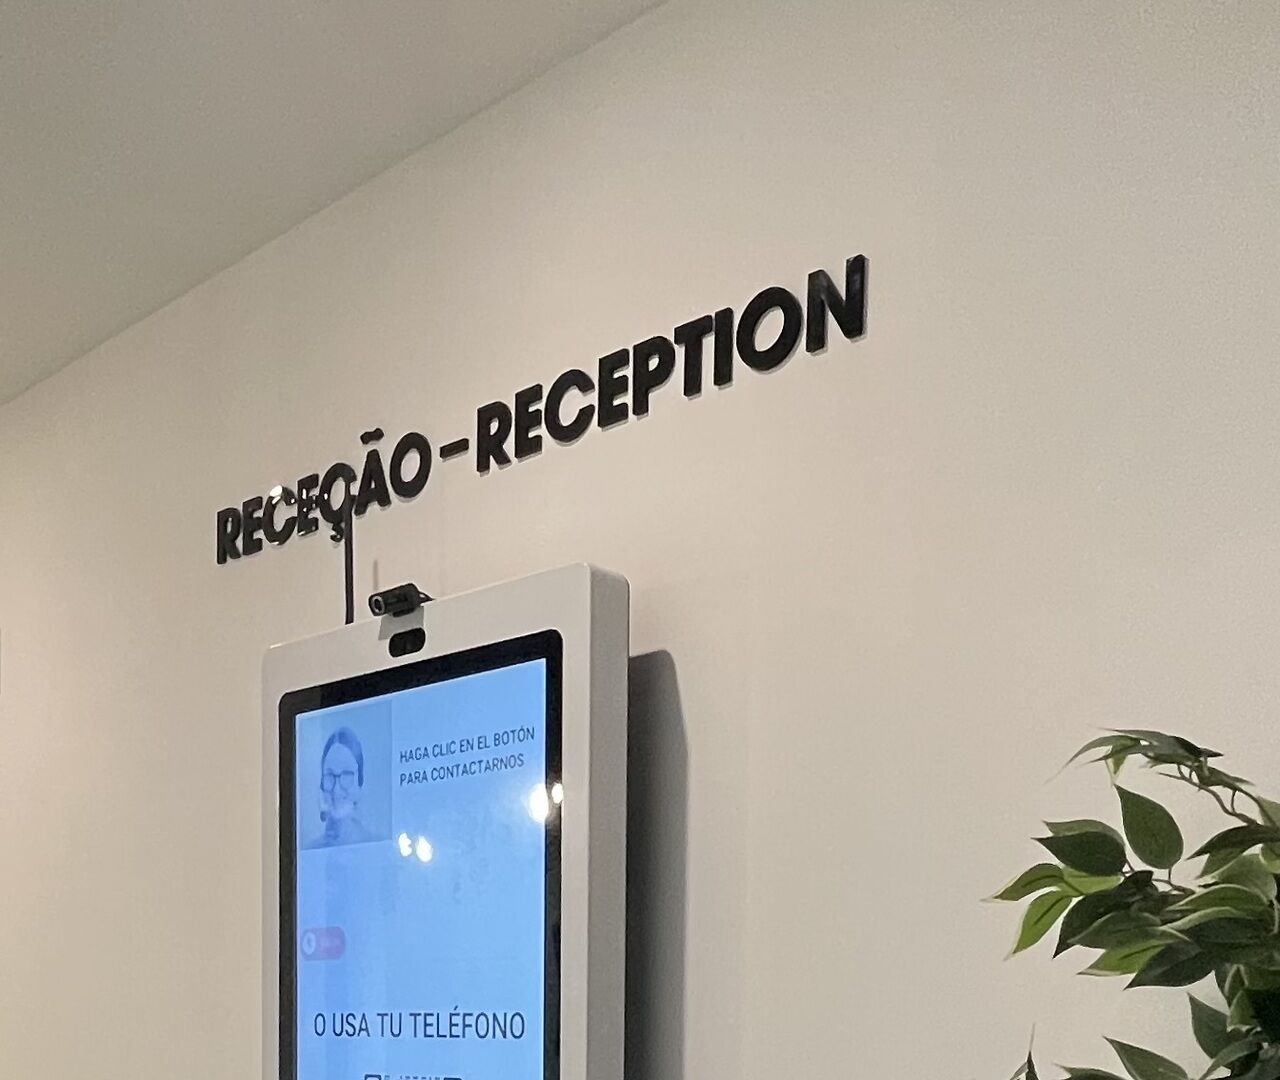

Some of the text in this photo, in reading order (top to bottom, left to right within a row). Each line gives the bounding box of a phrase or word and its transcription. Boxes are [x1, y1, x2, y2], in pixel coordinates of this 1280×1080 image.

[400, 726, 535, 763] HAGA CLIC EN EL BOTÓN
[400, 753, 524, 786] PARA CONTACTARNOS
[314, 1005, 525, 1040] O USA TU TELÉFONO
